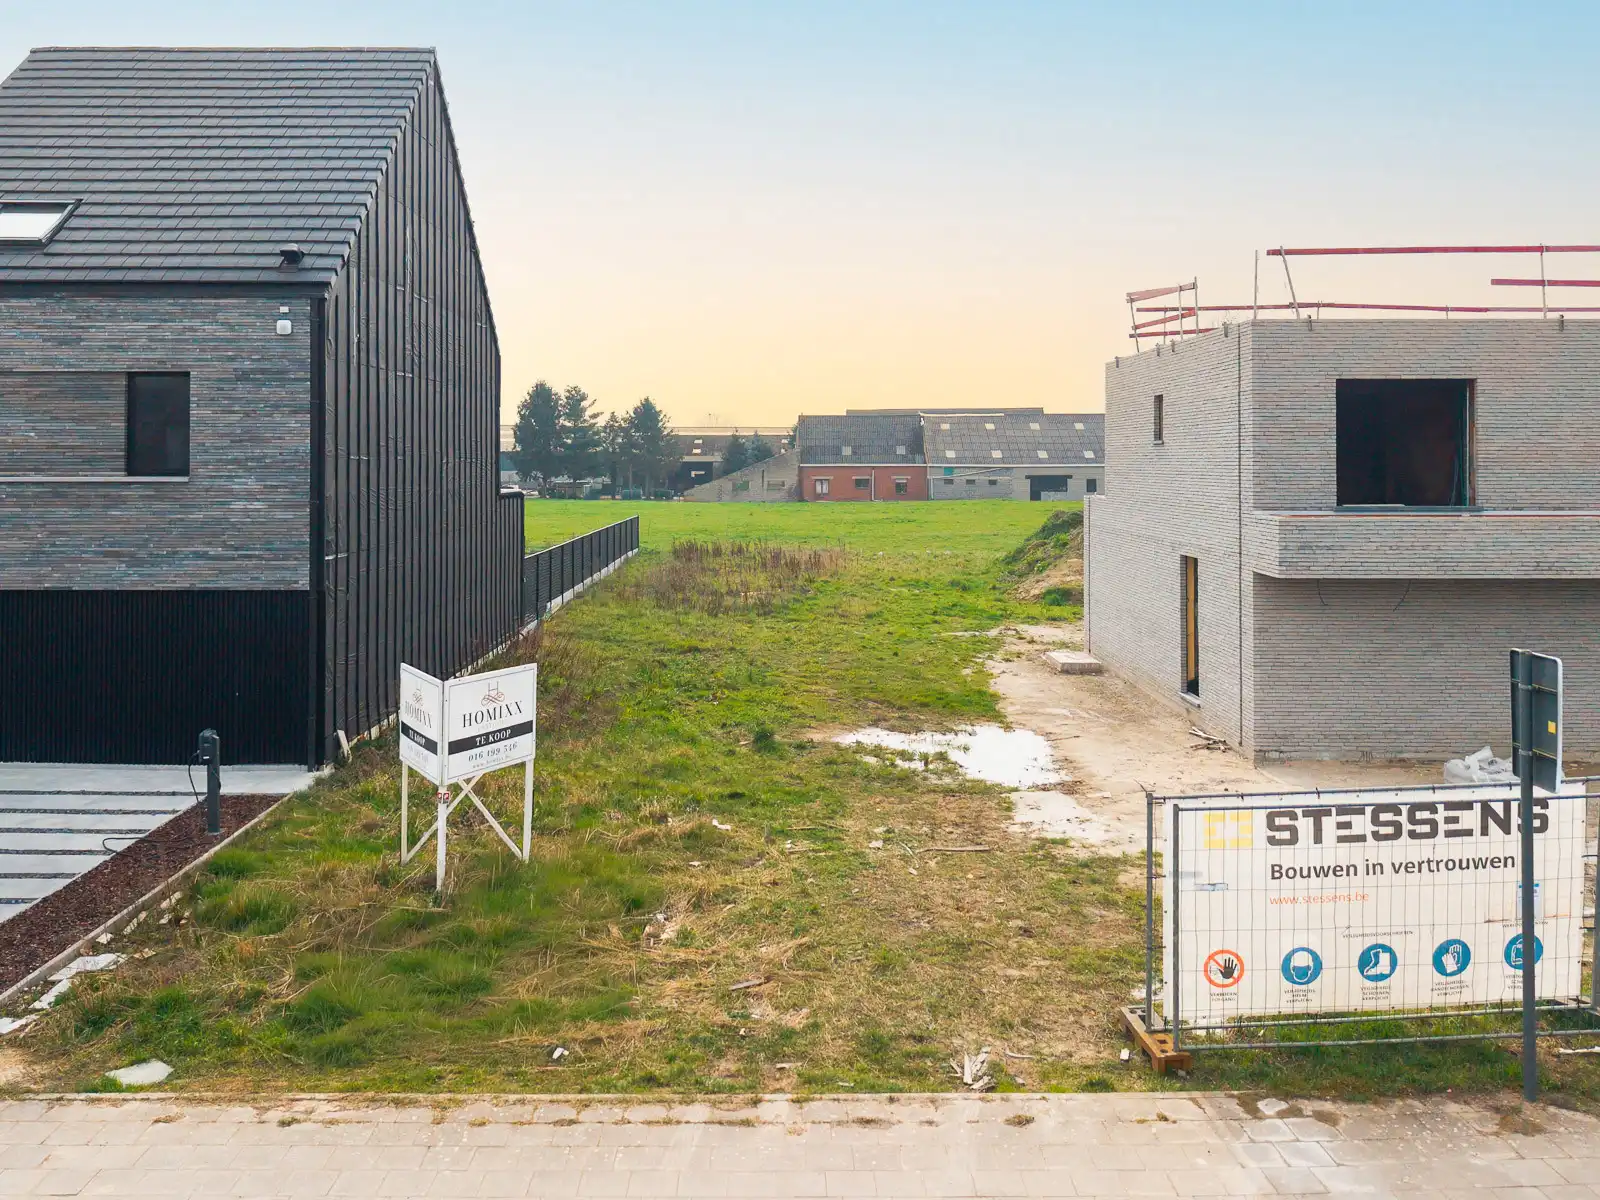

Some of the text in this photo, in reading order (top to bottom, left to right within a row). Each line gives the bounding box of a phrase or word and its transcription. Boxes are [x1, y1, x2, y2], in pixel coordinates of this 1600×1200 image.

[462, 700, 522, 728] HOMIXX
[475, 729, 511, 746] TE KOOP
[1266, 798, 1549, 846] STESSENS
[1270, 855, 1516, 880] Bouwen in vertrouwen
[1269, 891, 1370, 905] www.stessens.be
